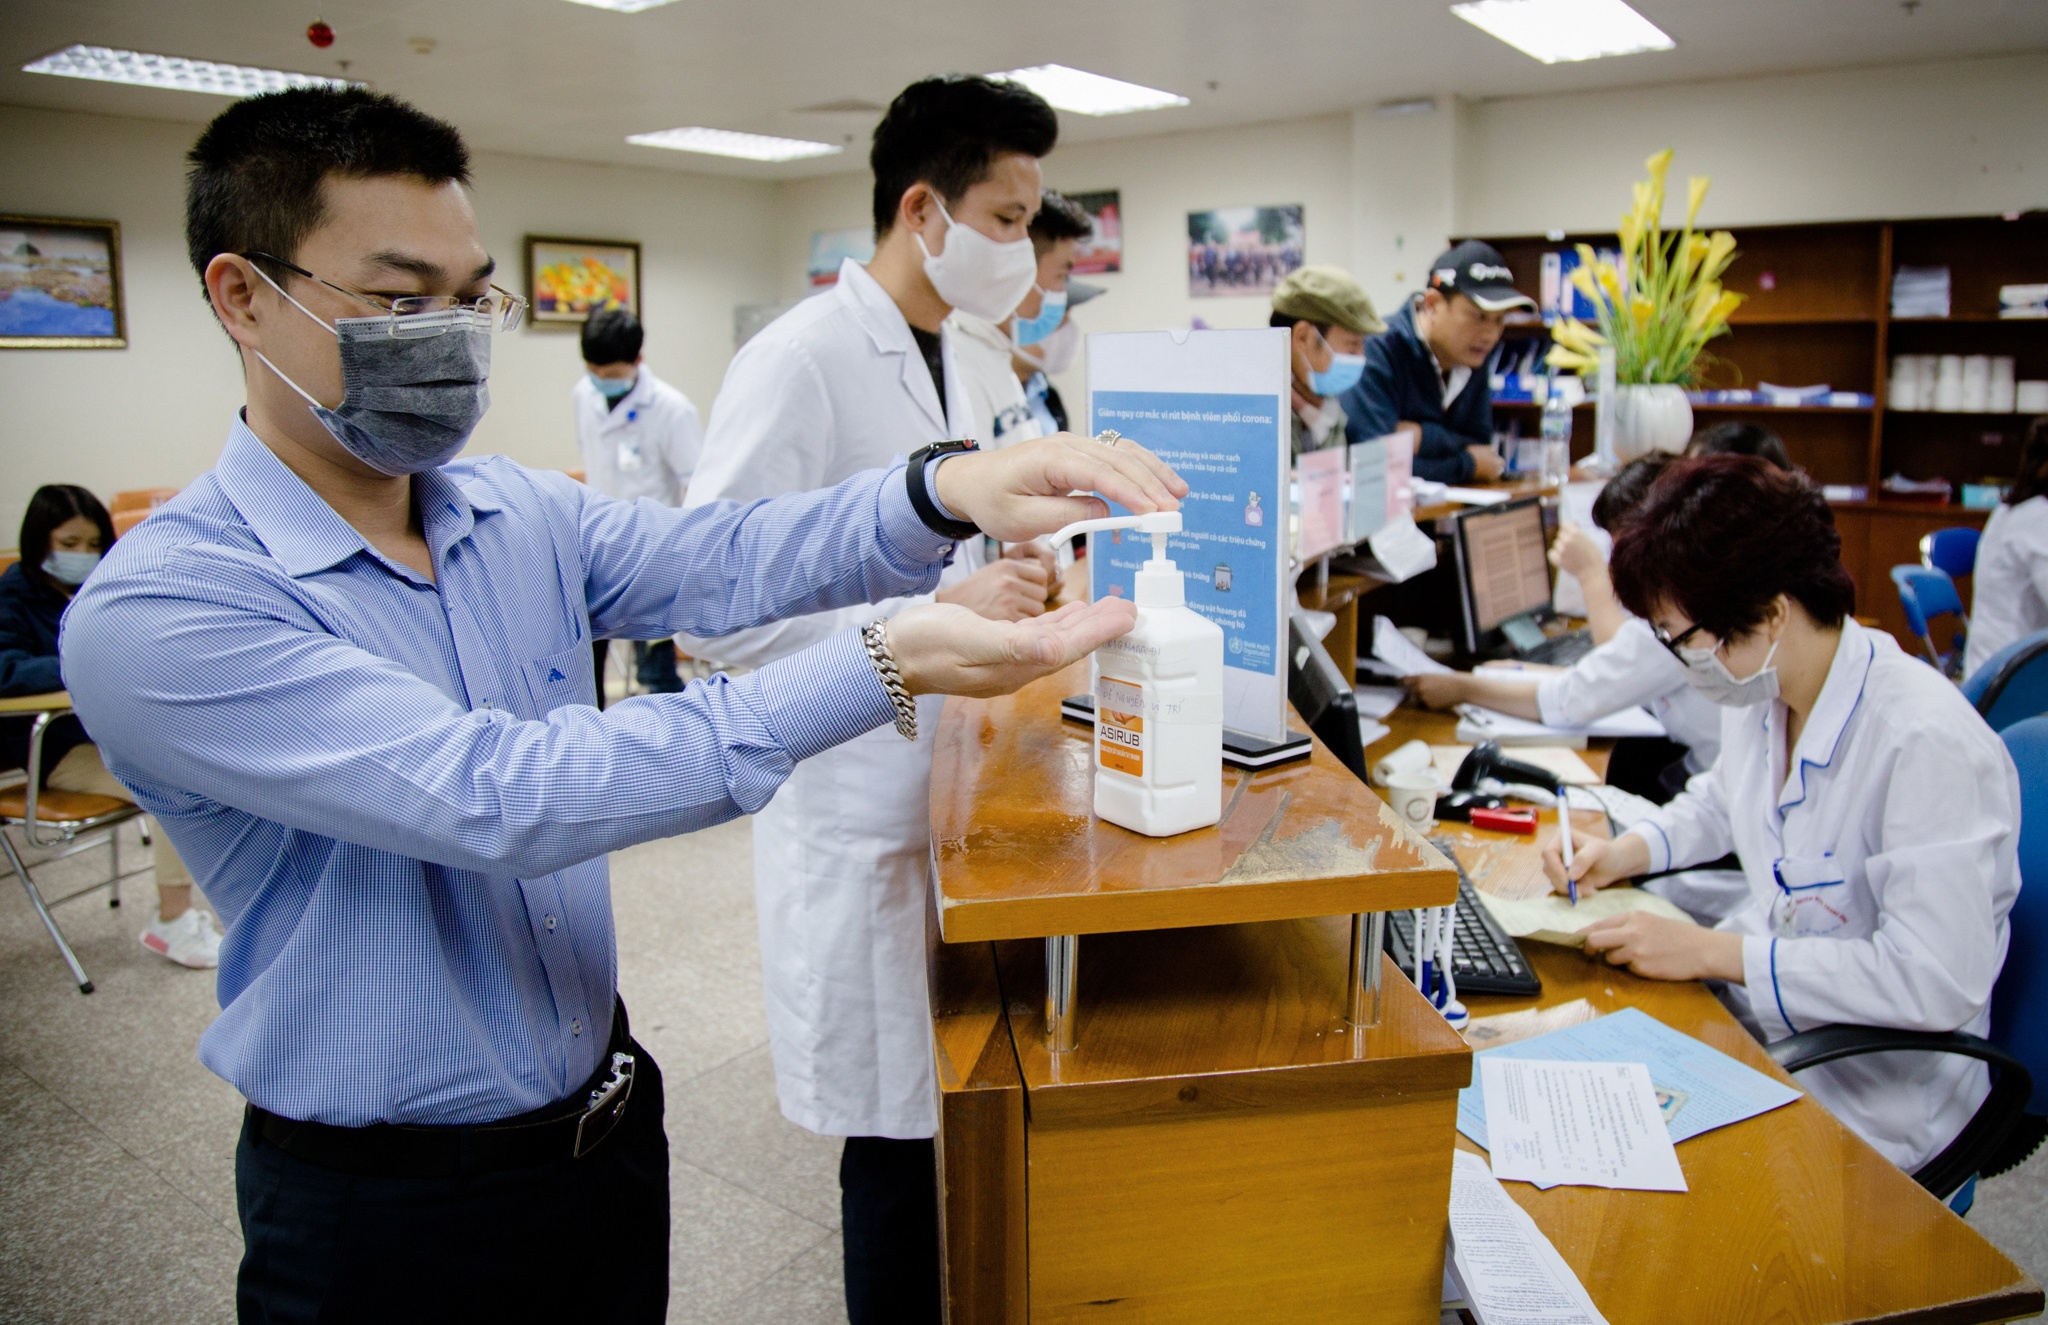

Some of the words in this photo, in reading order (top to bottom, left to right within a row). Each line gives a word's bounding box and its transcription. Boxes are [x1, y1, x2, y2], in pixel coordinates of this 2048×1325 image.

[1117, 410, 1134, 420] nguy
[1242, 414, 1272, 424] corona:
[1100, 725, 1140, 747] ASIRUB
